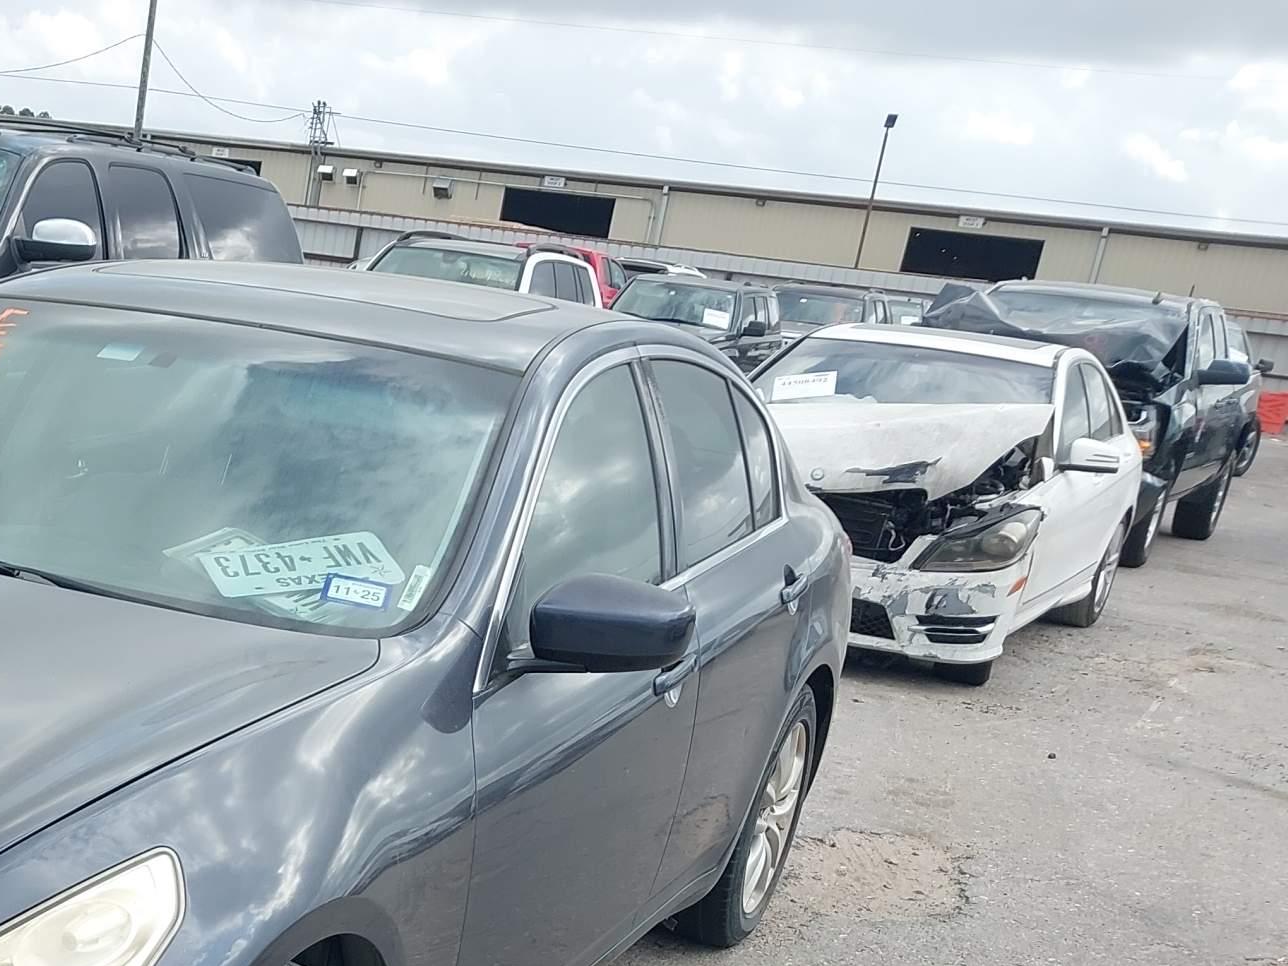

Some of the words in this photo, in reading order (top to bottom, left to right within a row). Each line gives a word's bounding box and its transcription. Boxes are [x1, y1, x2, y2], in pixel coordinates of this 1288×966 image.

[214, 551, 297, 578] 4373
[322, 542, 382, 569] VWF
[275, 573, 330, 588] EXAS
